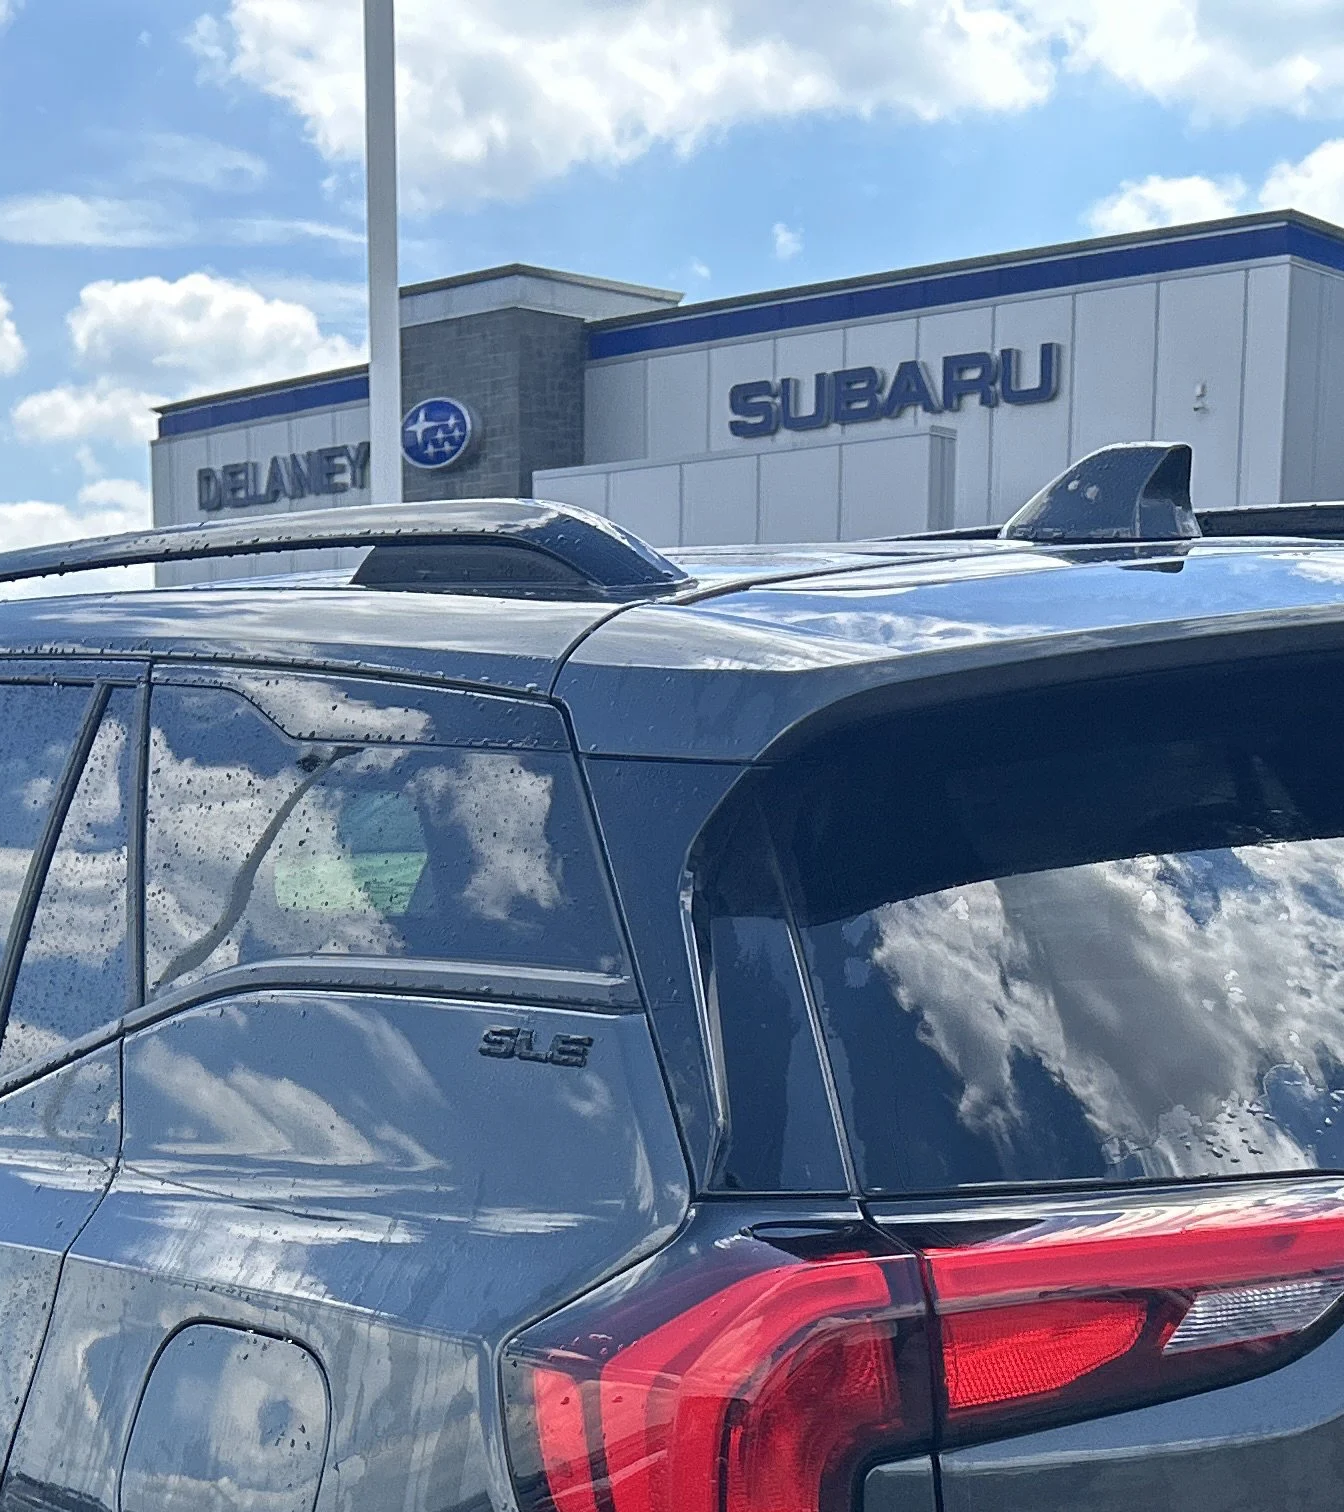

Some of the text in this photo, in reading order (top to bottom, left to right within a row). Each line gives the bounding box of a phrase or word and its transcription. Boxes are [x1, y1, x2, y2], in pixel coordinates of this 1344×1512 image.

[728, 341, 1062, 439] SUBARU
[197, 441, 371, 512] DELANEY
[478, 1025, 595, 1068] SLE
